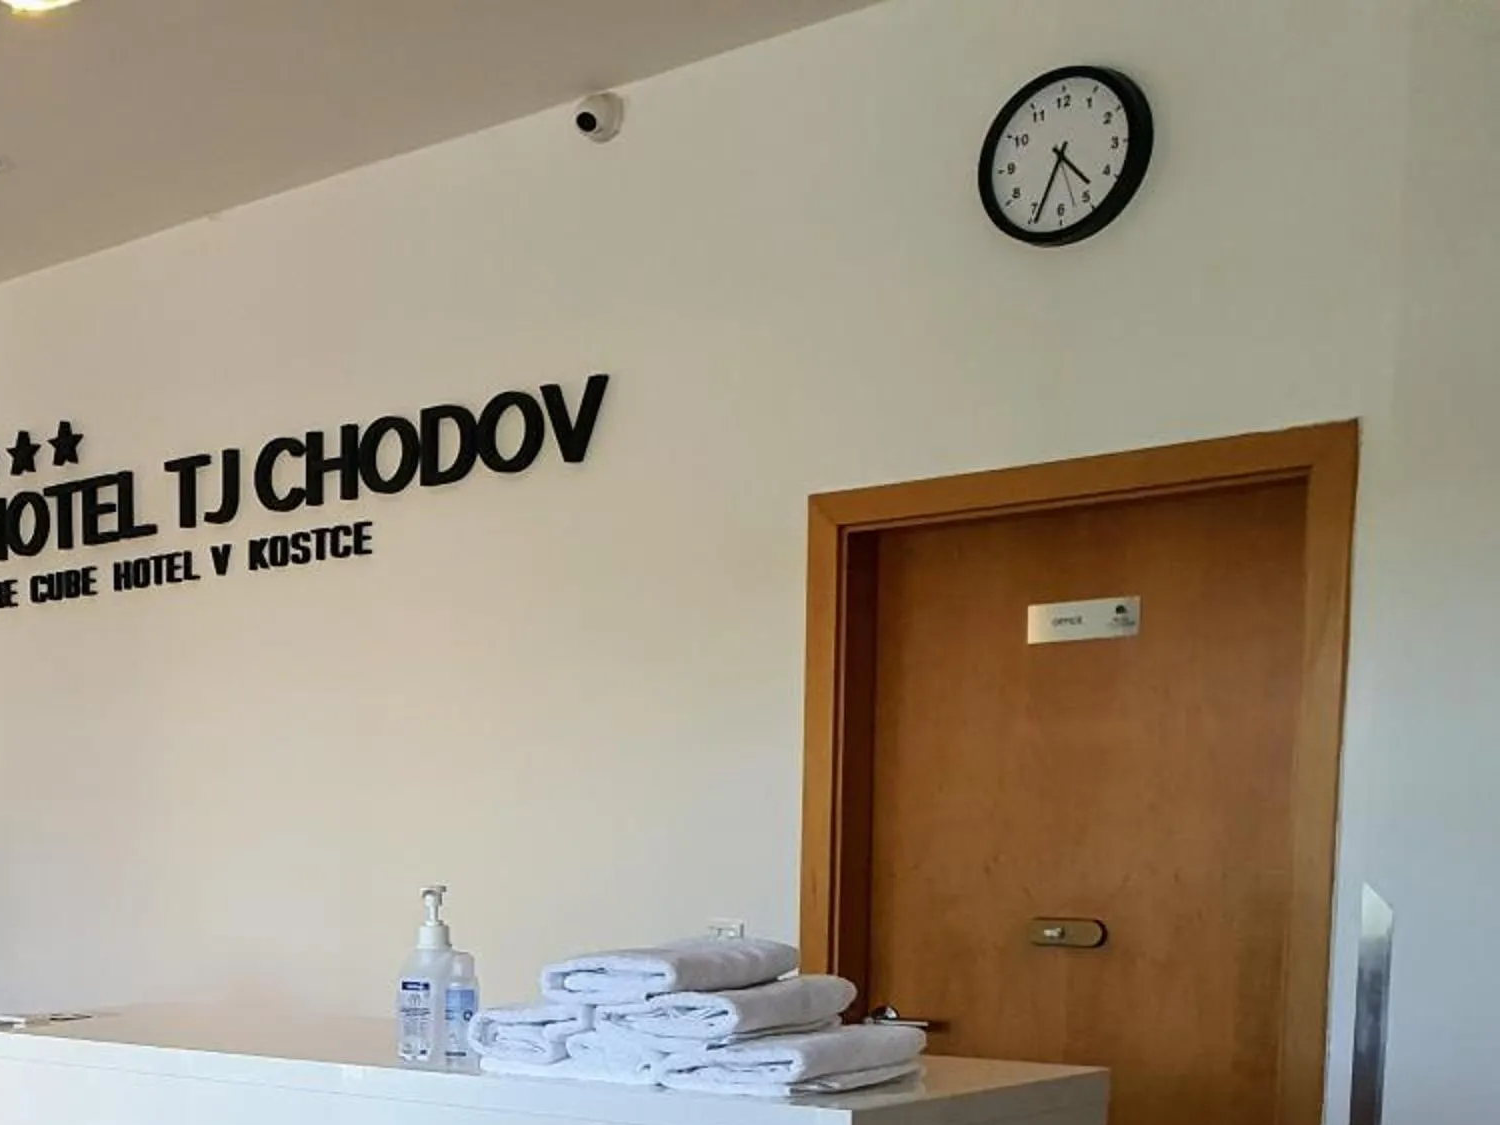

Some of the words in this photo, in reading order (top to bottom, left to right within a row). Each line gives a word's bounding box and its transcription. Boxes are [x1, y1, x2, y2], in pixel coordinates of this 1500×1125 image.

[1056, 95, 1071, 109] 12
[1086, 97, 1092, 109] 1
[1032, 110, 1045, 123] 11
[1103, 112, 1113, 125] 2
[1014, 134, 1029, 147] 10
[1111, 136, 1119, 149] 3
[1007, 163, 1016, 175] 9
[1103, 164, 1111, 176] 4
[1012, 188, 1021, 199] 8
[1082, 191, 1091, 203] 5
[1057, 204, 1065, 217] 6
[163, 448, 241, 529] TJ
[253, 373, 610, 513] CHODOV
[29, 566, 98, 604] CUBE
[113, 550, 201, 592] HOTEL
[210, 543, 232, 576] V
[248, 521, 373, 571] KOSTCE
